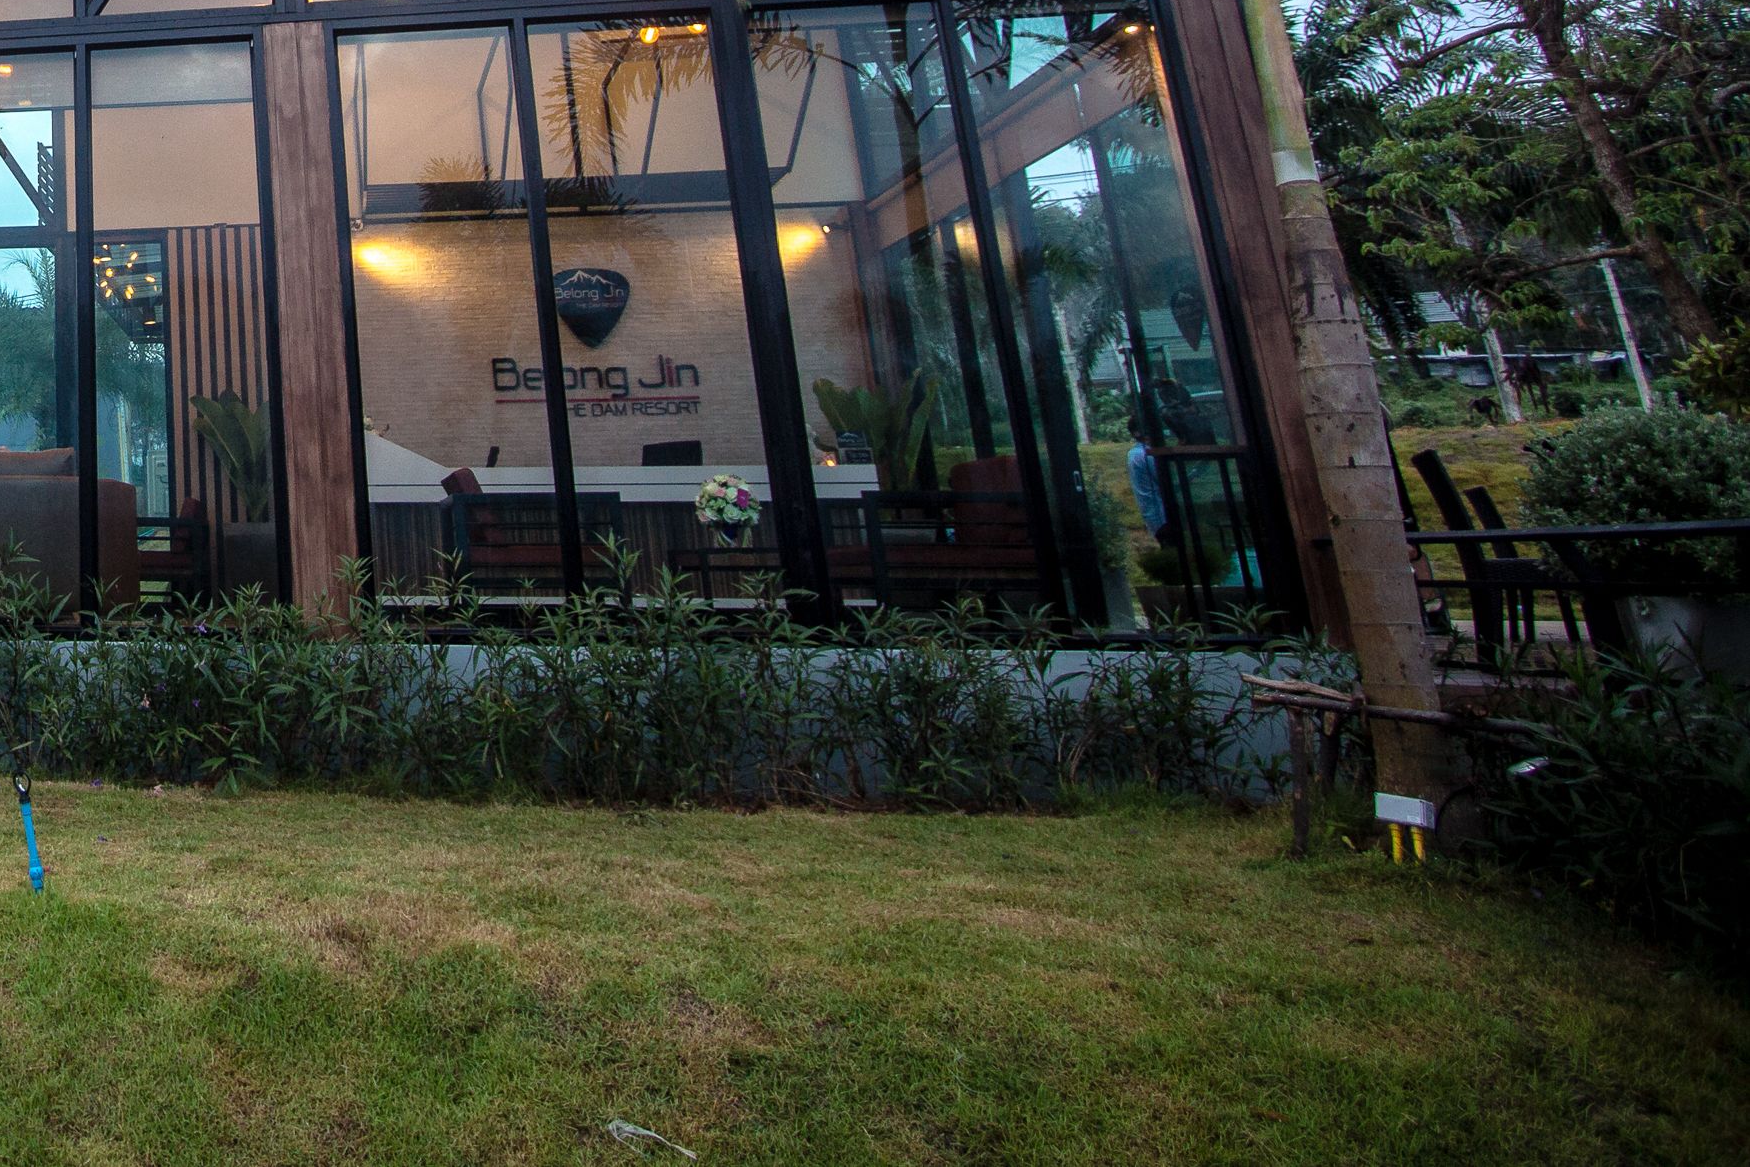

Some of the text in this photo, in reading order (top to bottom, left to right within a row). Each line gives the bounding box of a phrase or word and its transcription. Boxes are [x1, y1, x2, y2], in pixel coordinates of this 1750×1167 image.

[491, 354, 700, 398] Beong Jin
[567, 400, 700, 418] HE DAM RESORT
